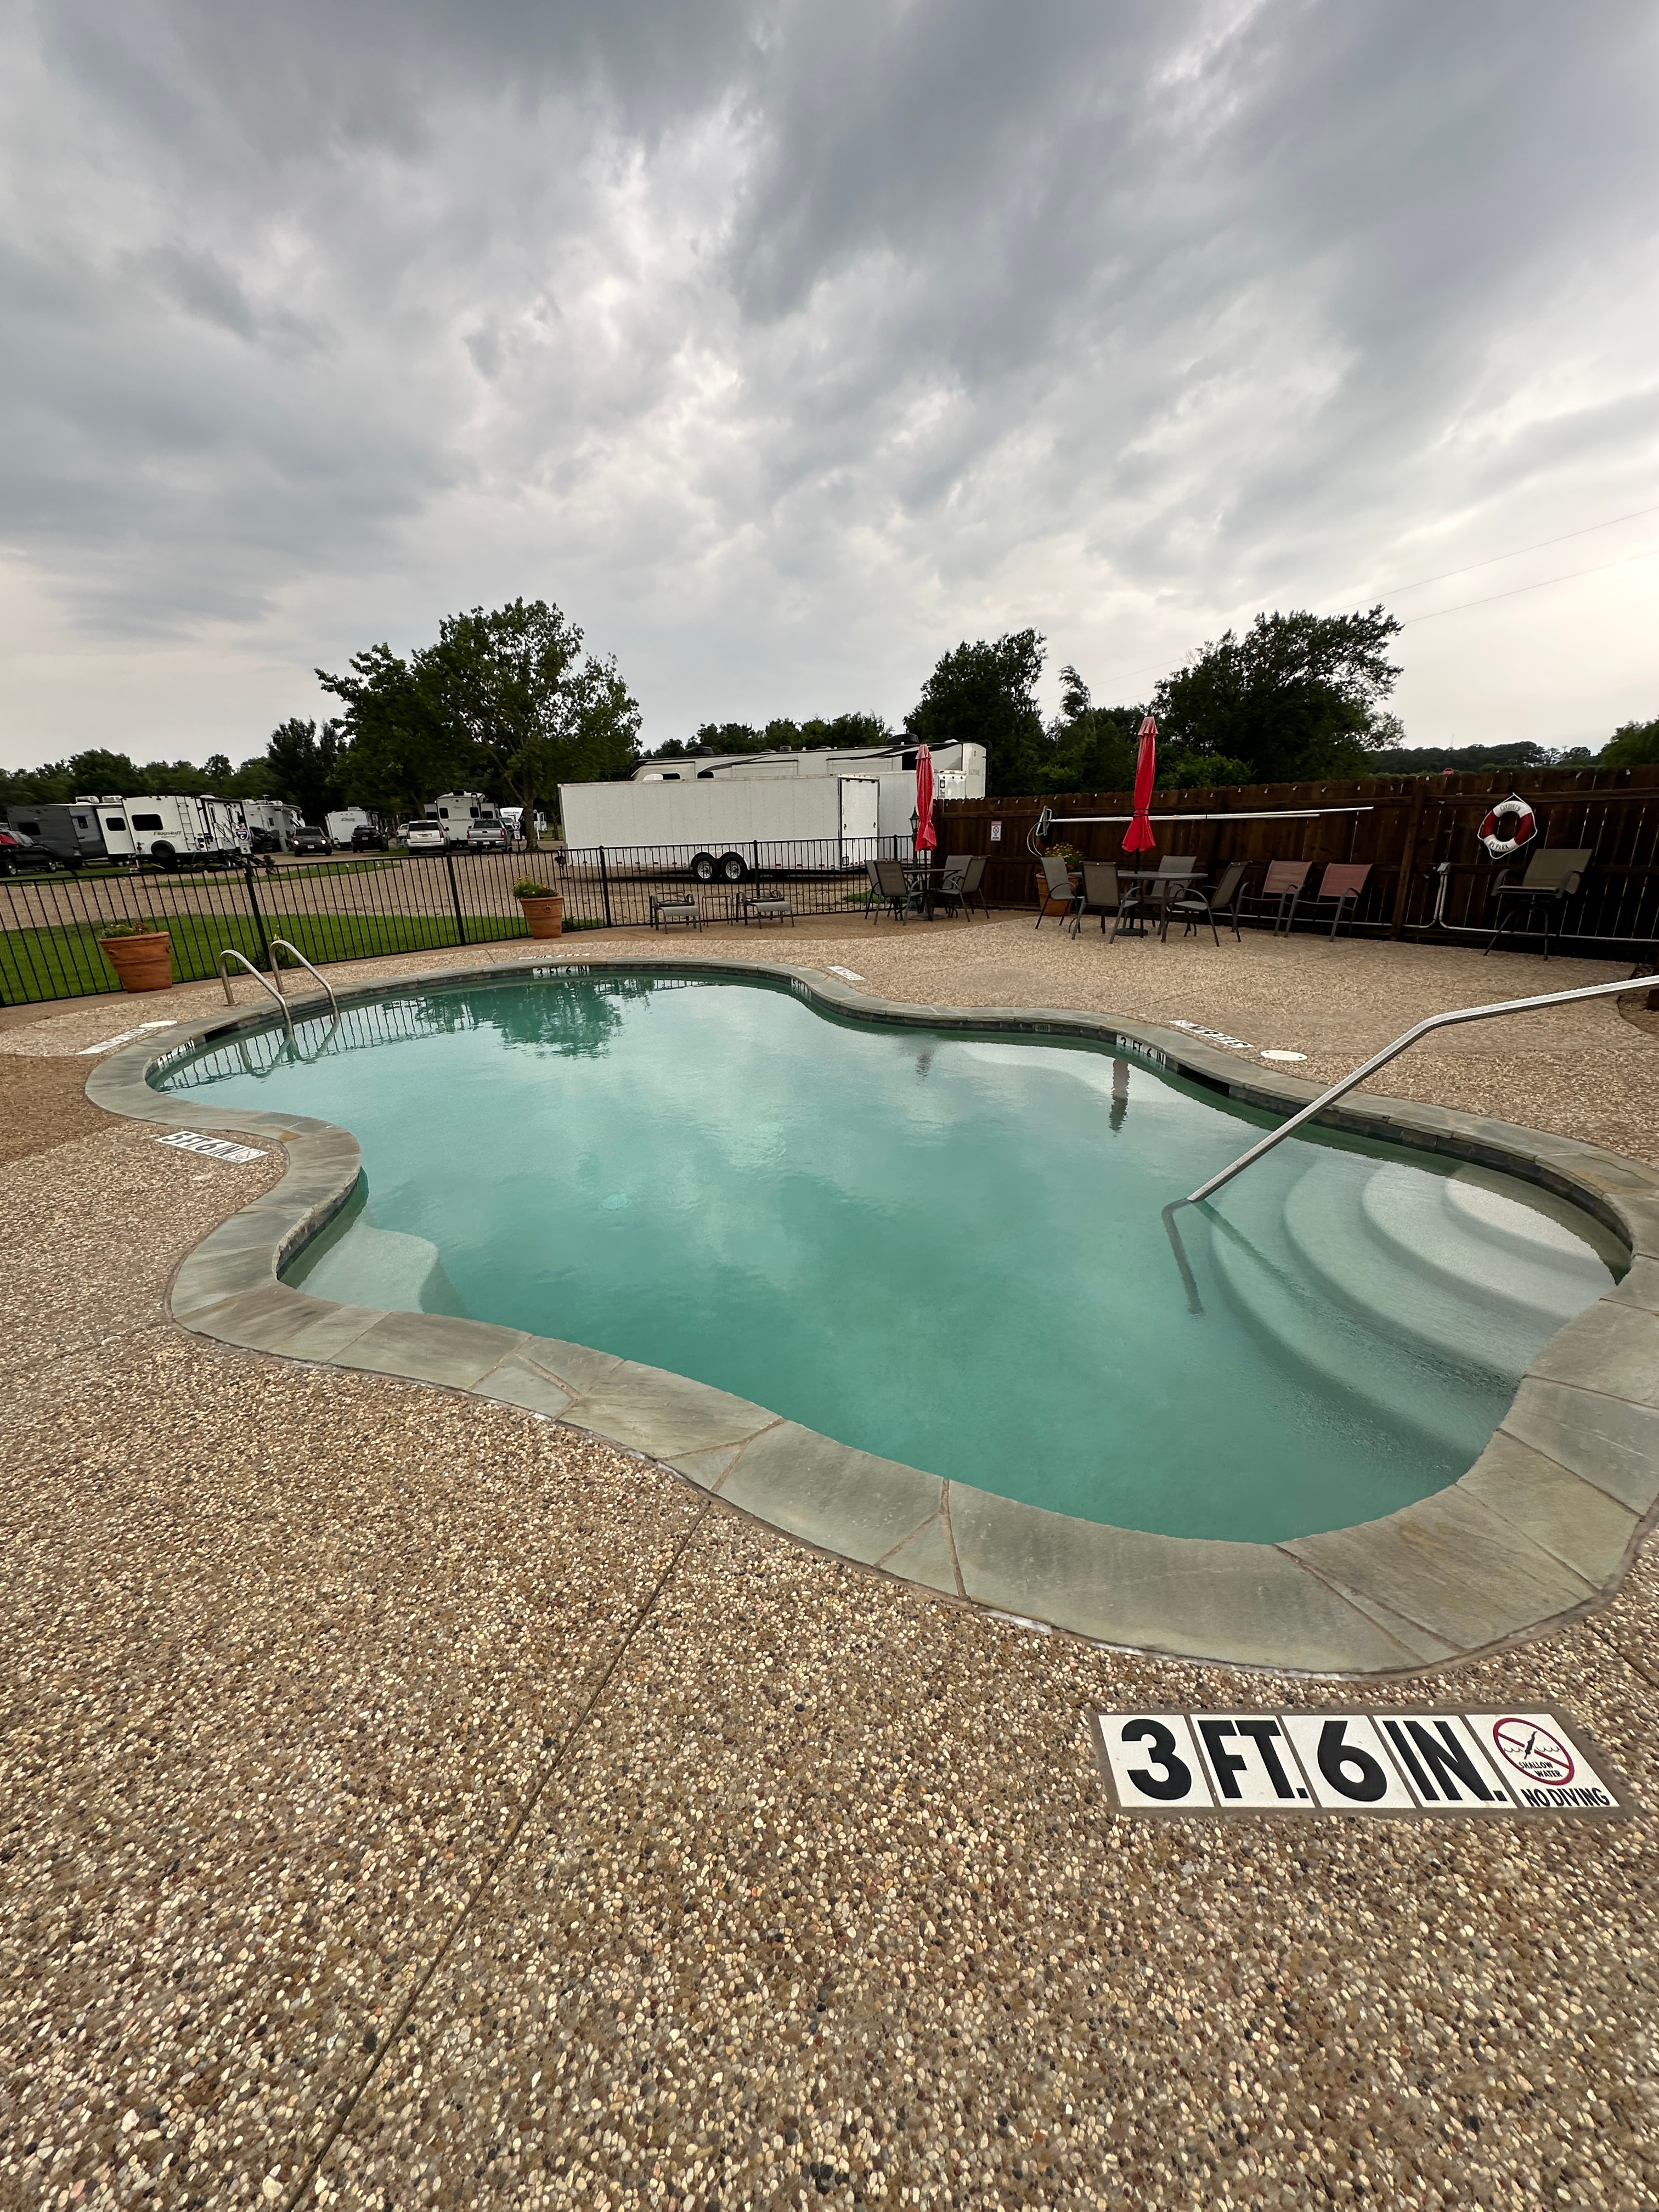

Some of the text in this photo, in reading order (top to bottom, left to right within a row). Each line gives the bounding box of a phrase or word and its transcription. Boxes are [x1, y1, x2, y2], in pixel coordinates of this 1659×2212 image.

[549, 967, 559, 975] FT
[1132, 1040, 1143, 1053] FT
[1146, 1048, 1152, 1058] 6
[1156, 1051, 1165, 1065] IN
[162, 1132, 193, 1142] 5
[195, 1142, 225, 1151] 6
[1121, 1718, 1506, 1802] 3 FT. 6 IN.
[1520, 1787, 1610, 1807] NO DIVING
